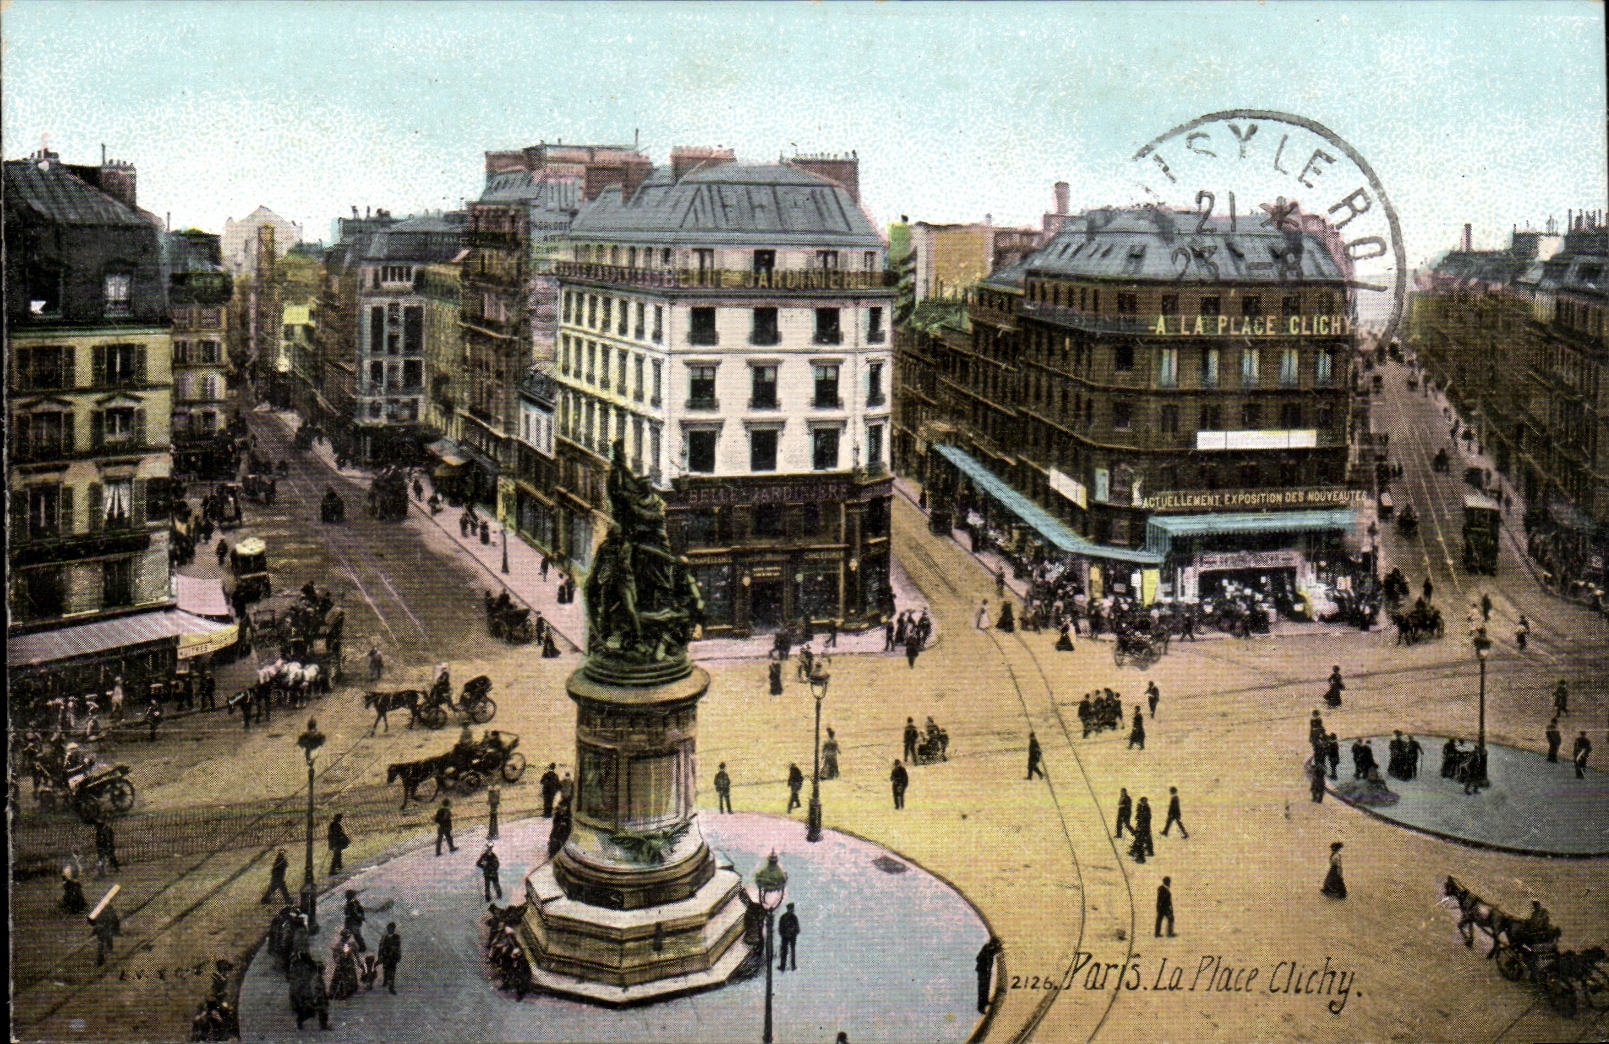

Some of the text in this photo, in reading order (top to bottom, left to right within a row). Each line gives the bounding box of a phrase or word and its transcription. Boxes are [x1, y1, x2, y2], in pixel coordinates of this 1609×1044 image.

[1154, 315, 1352, 336] A LA PLACE CLICHY
[1142, 493, 1220, 509] ACTUELLEMENT
[1224, 492, 1283, 507] EXPOSITION
[1285, 491, 1304, 504] DES
